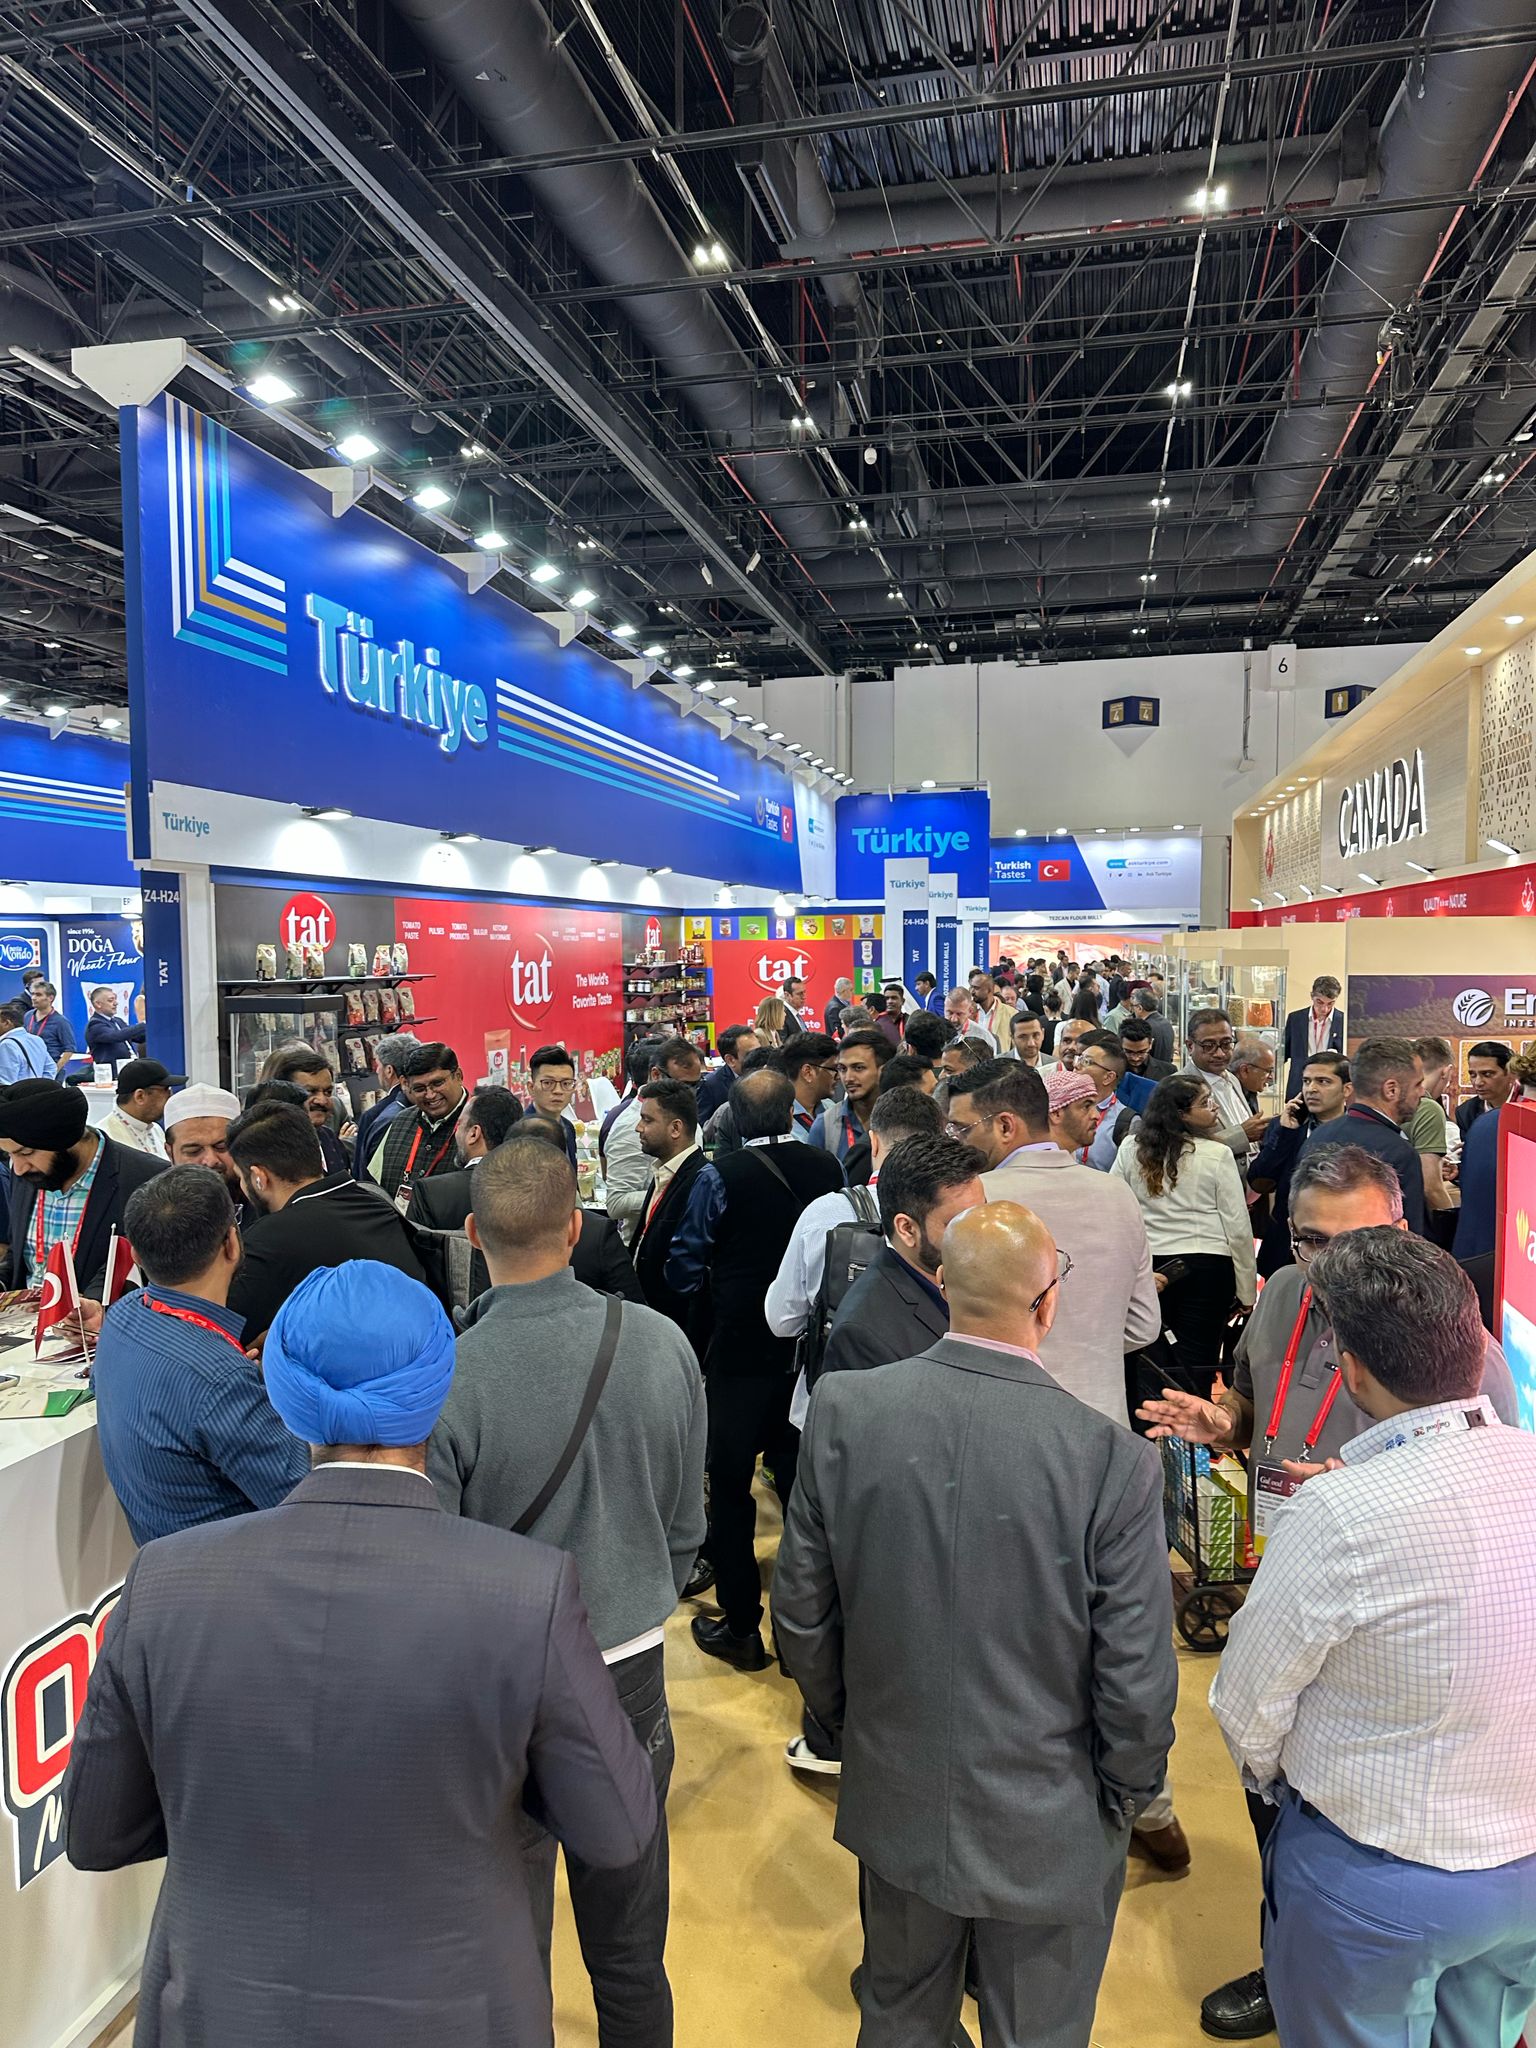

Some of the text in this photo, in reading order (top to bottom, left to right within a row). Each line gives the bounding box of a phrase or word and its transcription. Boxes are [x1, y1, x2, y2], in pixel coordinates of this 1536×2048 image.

[306, 592, 489, 752] Türkiye
[1278, 658, 1288, 673] 6
[1338, 747, 1428, 859] CANADA
[162, 812, 210, 837] Türkiye
[852, 826, 970, 858] Türkiye
[995, 861, 1032, 871] Turkish
[996, 870, 1026, 879] Tastes
[890, 880, 926, 889] Türkiye
[144, 889, 180, 904] Z4-H24
[929, 892, 954, 900] ürkiye
[286, 906, 331, 948] tat
[68, 935, 115, 953] DOĞA
[912, 949, 920, 962] TAT
[67, 952, 141, 978] Wheat Flour
[159, 959, 169, 987] TAT
[757, 954, 809, 982] tat
[510, 949, 553, 1006] tat
[576, 974, 588, 988] The
[572, 993, 613, 1009] Favorite Taste
